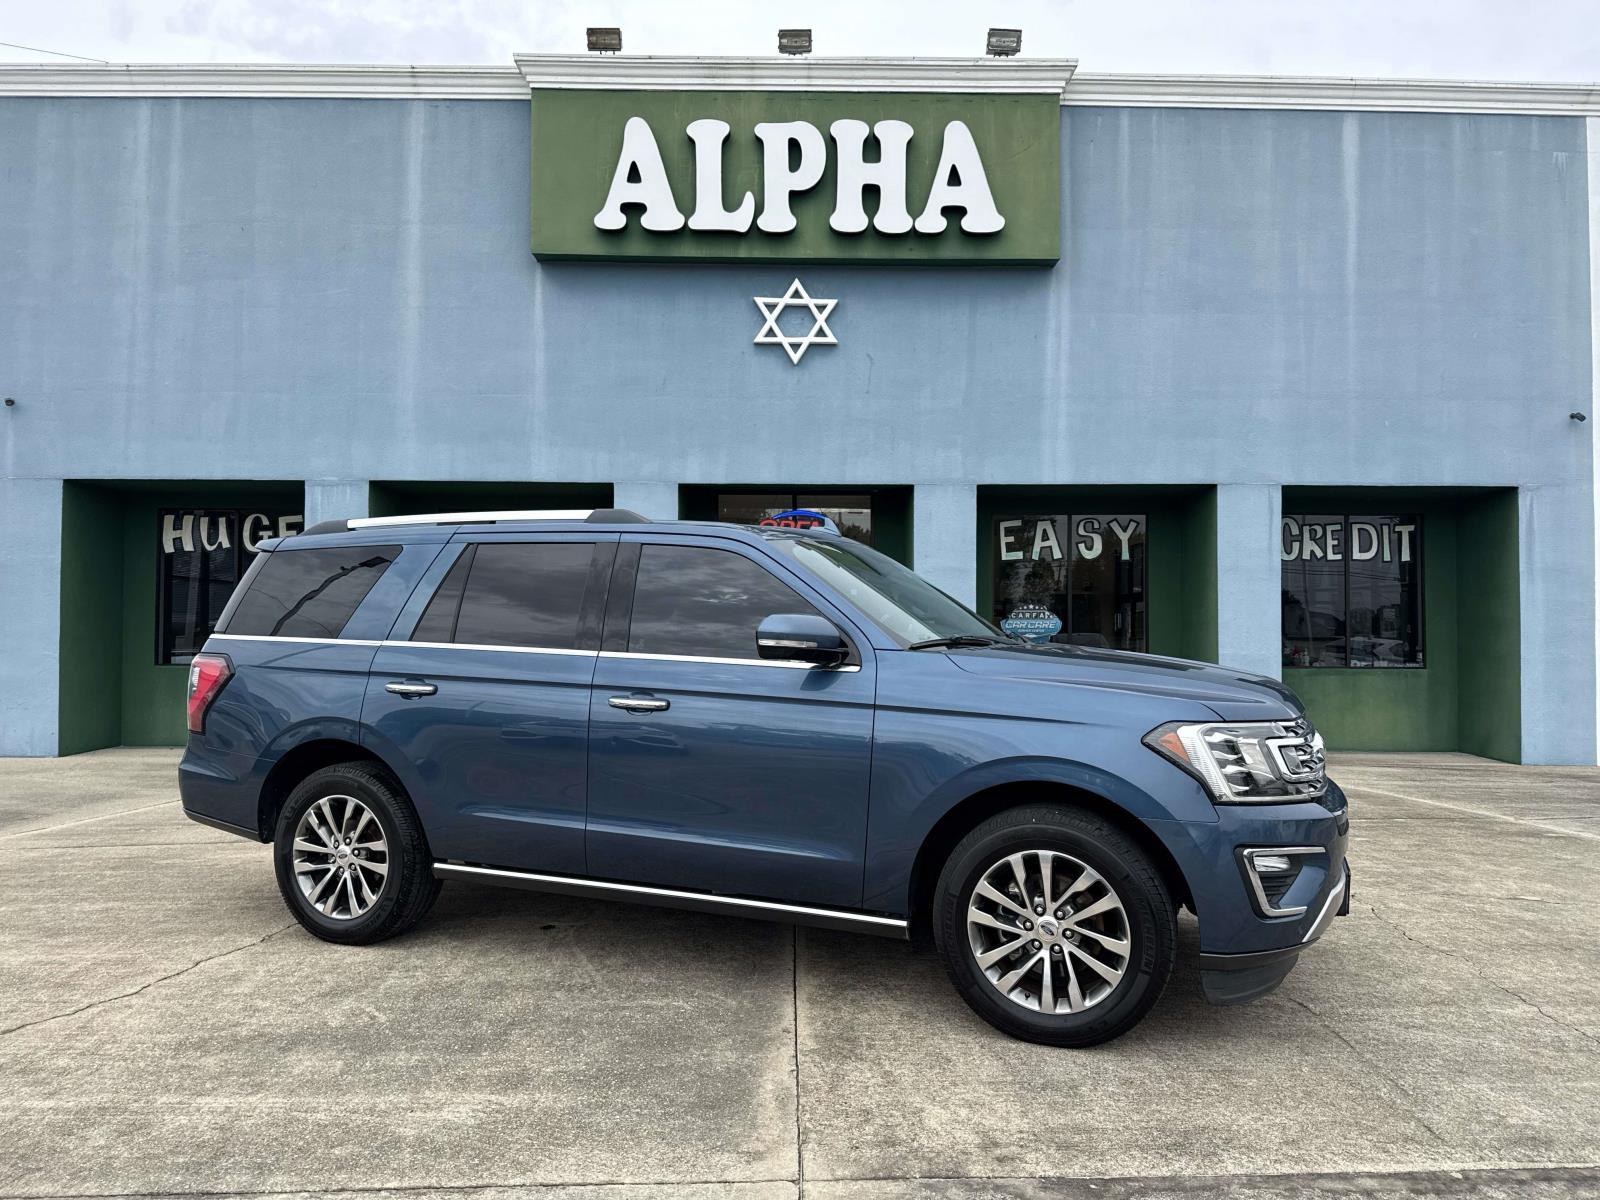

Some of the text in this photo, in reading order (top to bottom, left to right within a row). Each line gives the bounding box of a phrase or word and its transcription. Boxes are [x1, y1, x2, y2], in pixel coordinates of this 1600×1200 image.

[594, 116, 1005, 234] ALPHA
[1000, 518, 1140, 560] EASY
[1281, 516, 1415, 562] CREDIT
[1005, 621, 1056, 629] CAR CARE
